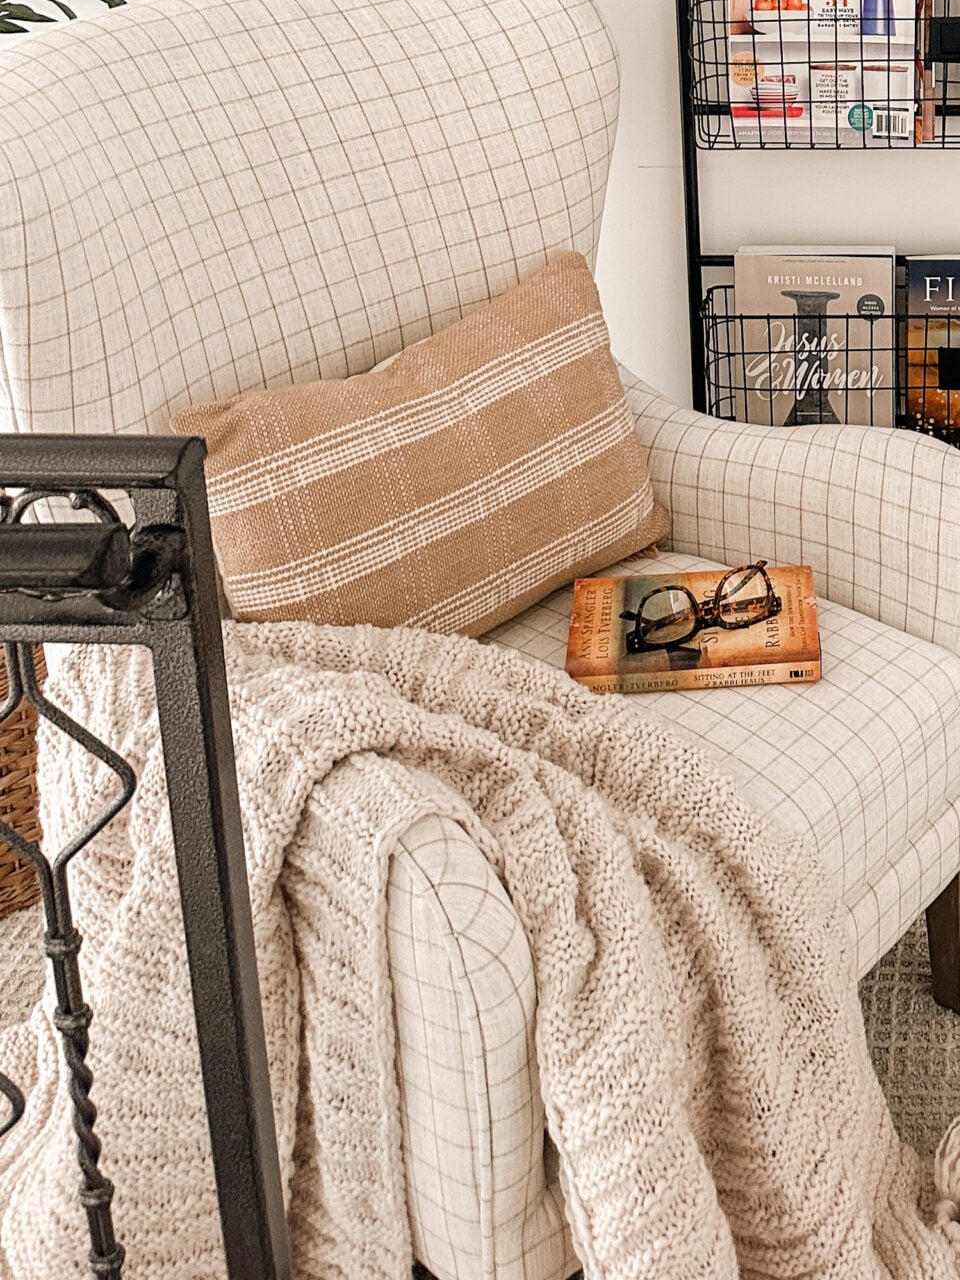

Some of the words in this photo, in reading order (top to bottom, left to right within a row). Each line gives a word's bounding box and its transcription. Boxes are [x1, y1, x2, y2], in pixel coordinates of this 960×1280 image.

[767, 275, 800, 285] KRISTI
[805, 276, 863, 286] MCLELLAND
[745, 321, 847, 377] Jesus
[782, 358, 884, 401] Women
[581, 589, 598, 635] SPANGLER
[598, 587, 614, 634] TVERBERG
[765, 618, 781, 649] RABB
[579, 638, 592, 659] ANN
[596, 636, 610, 659] LOIS
[630, 679, 679, 690] TVERBERG
[694, 673, 725, 682] SITTING
[727, 671, 738, 679] AT
[739, 670, 755, 678] THE
[757, 669, 776, 677] FEET
[712, 679, 739, 687] RABBI
[740, 677, 765, 685] JESUS
